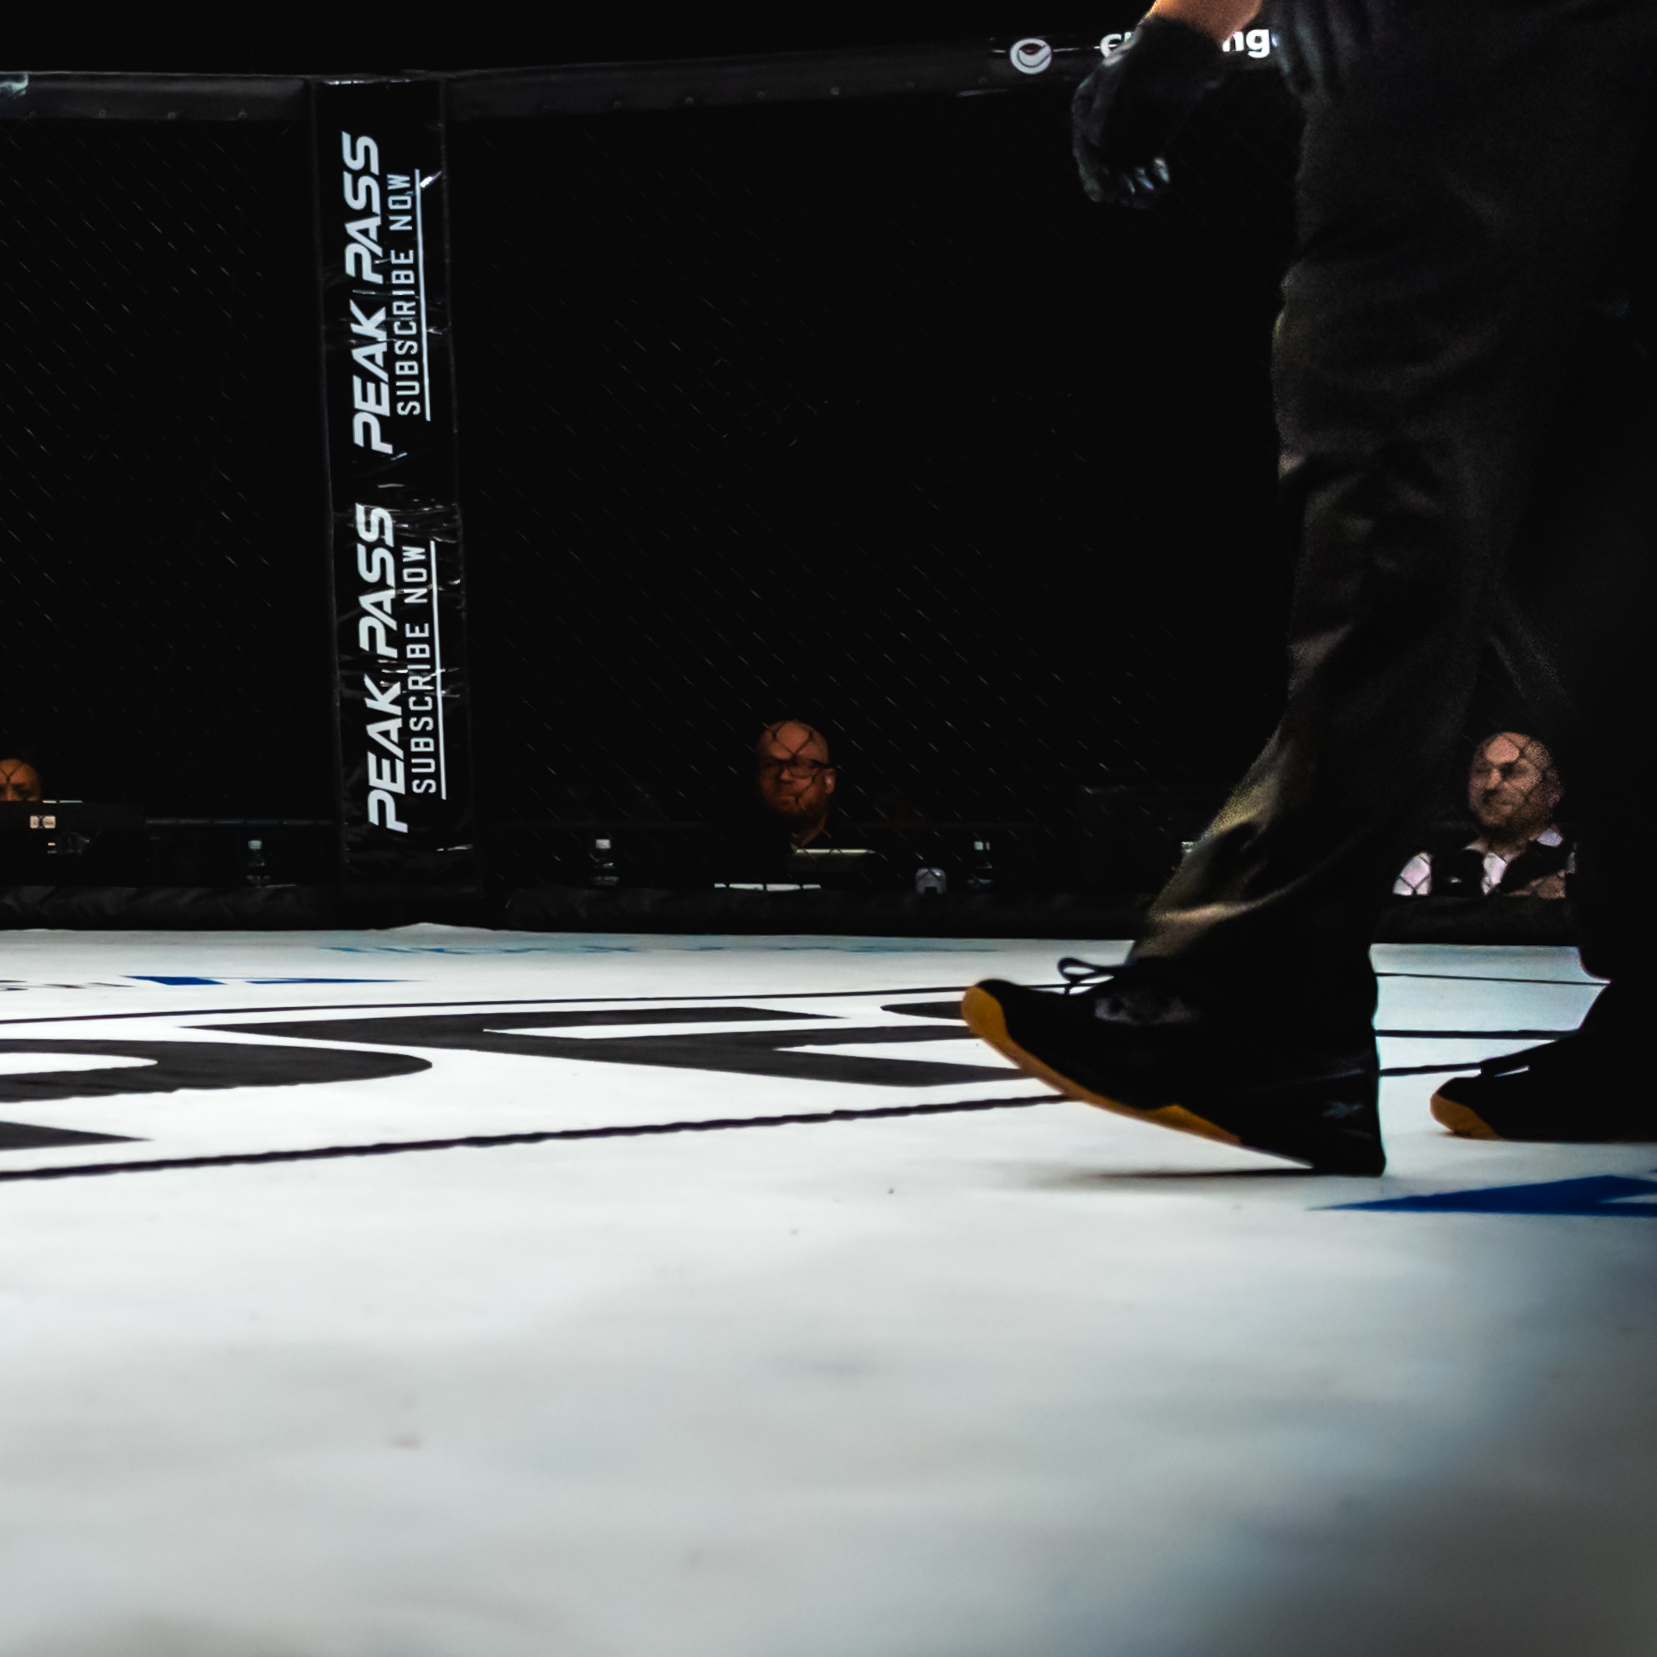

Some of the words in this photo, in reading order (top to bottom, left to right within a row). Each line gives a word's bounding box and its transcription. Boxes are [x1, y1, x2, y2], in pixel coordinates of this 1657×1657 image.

[341, 131, 384, 284] PASS
[387, 174, 413, 231] NOW
[348, 299, 394, 455] PEAK
[390, 249, 421, 417] SUBSCRIBE
[355, 502, 398, 659] PASS
[401, 546, 428, 603] NOW
[363, 674, 408, 834] PEAK
[405, 623, 436, 794] SUBSCRIBE
